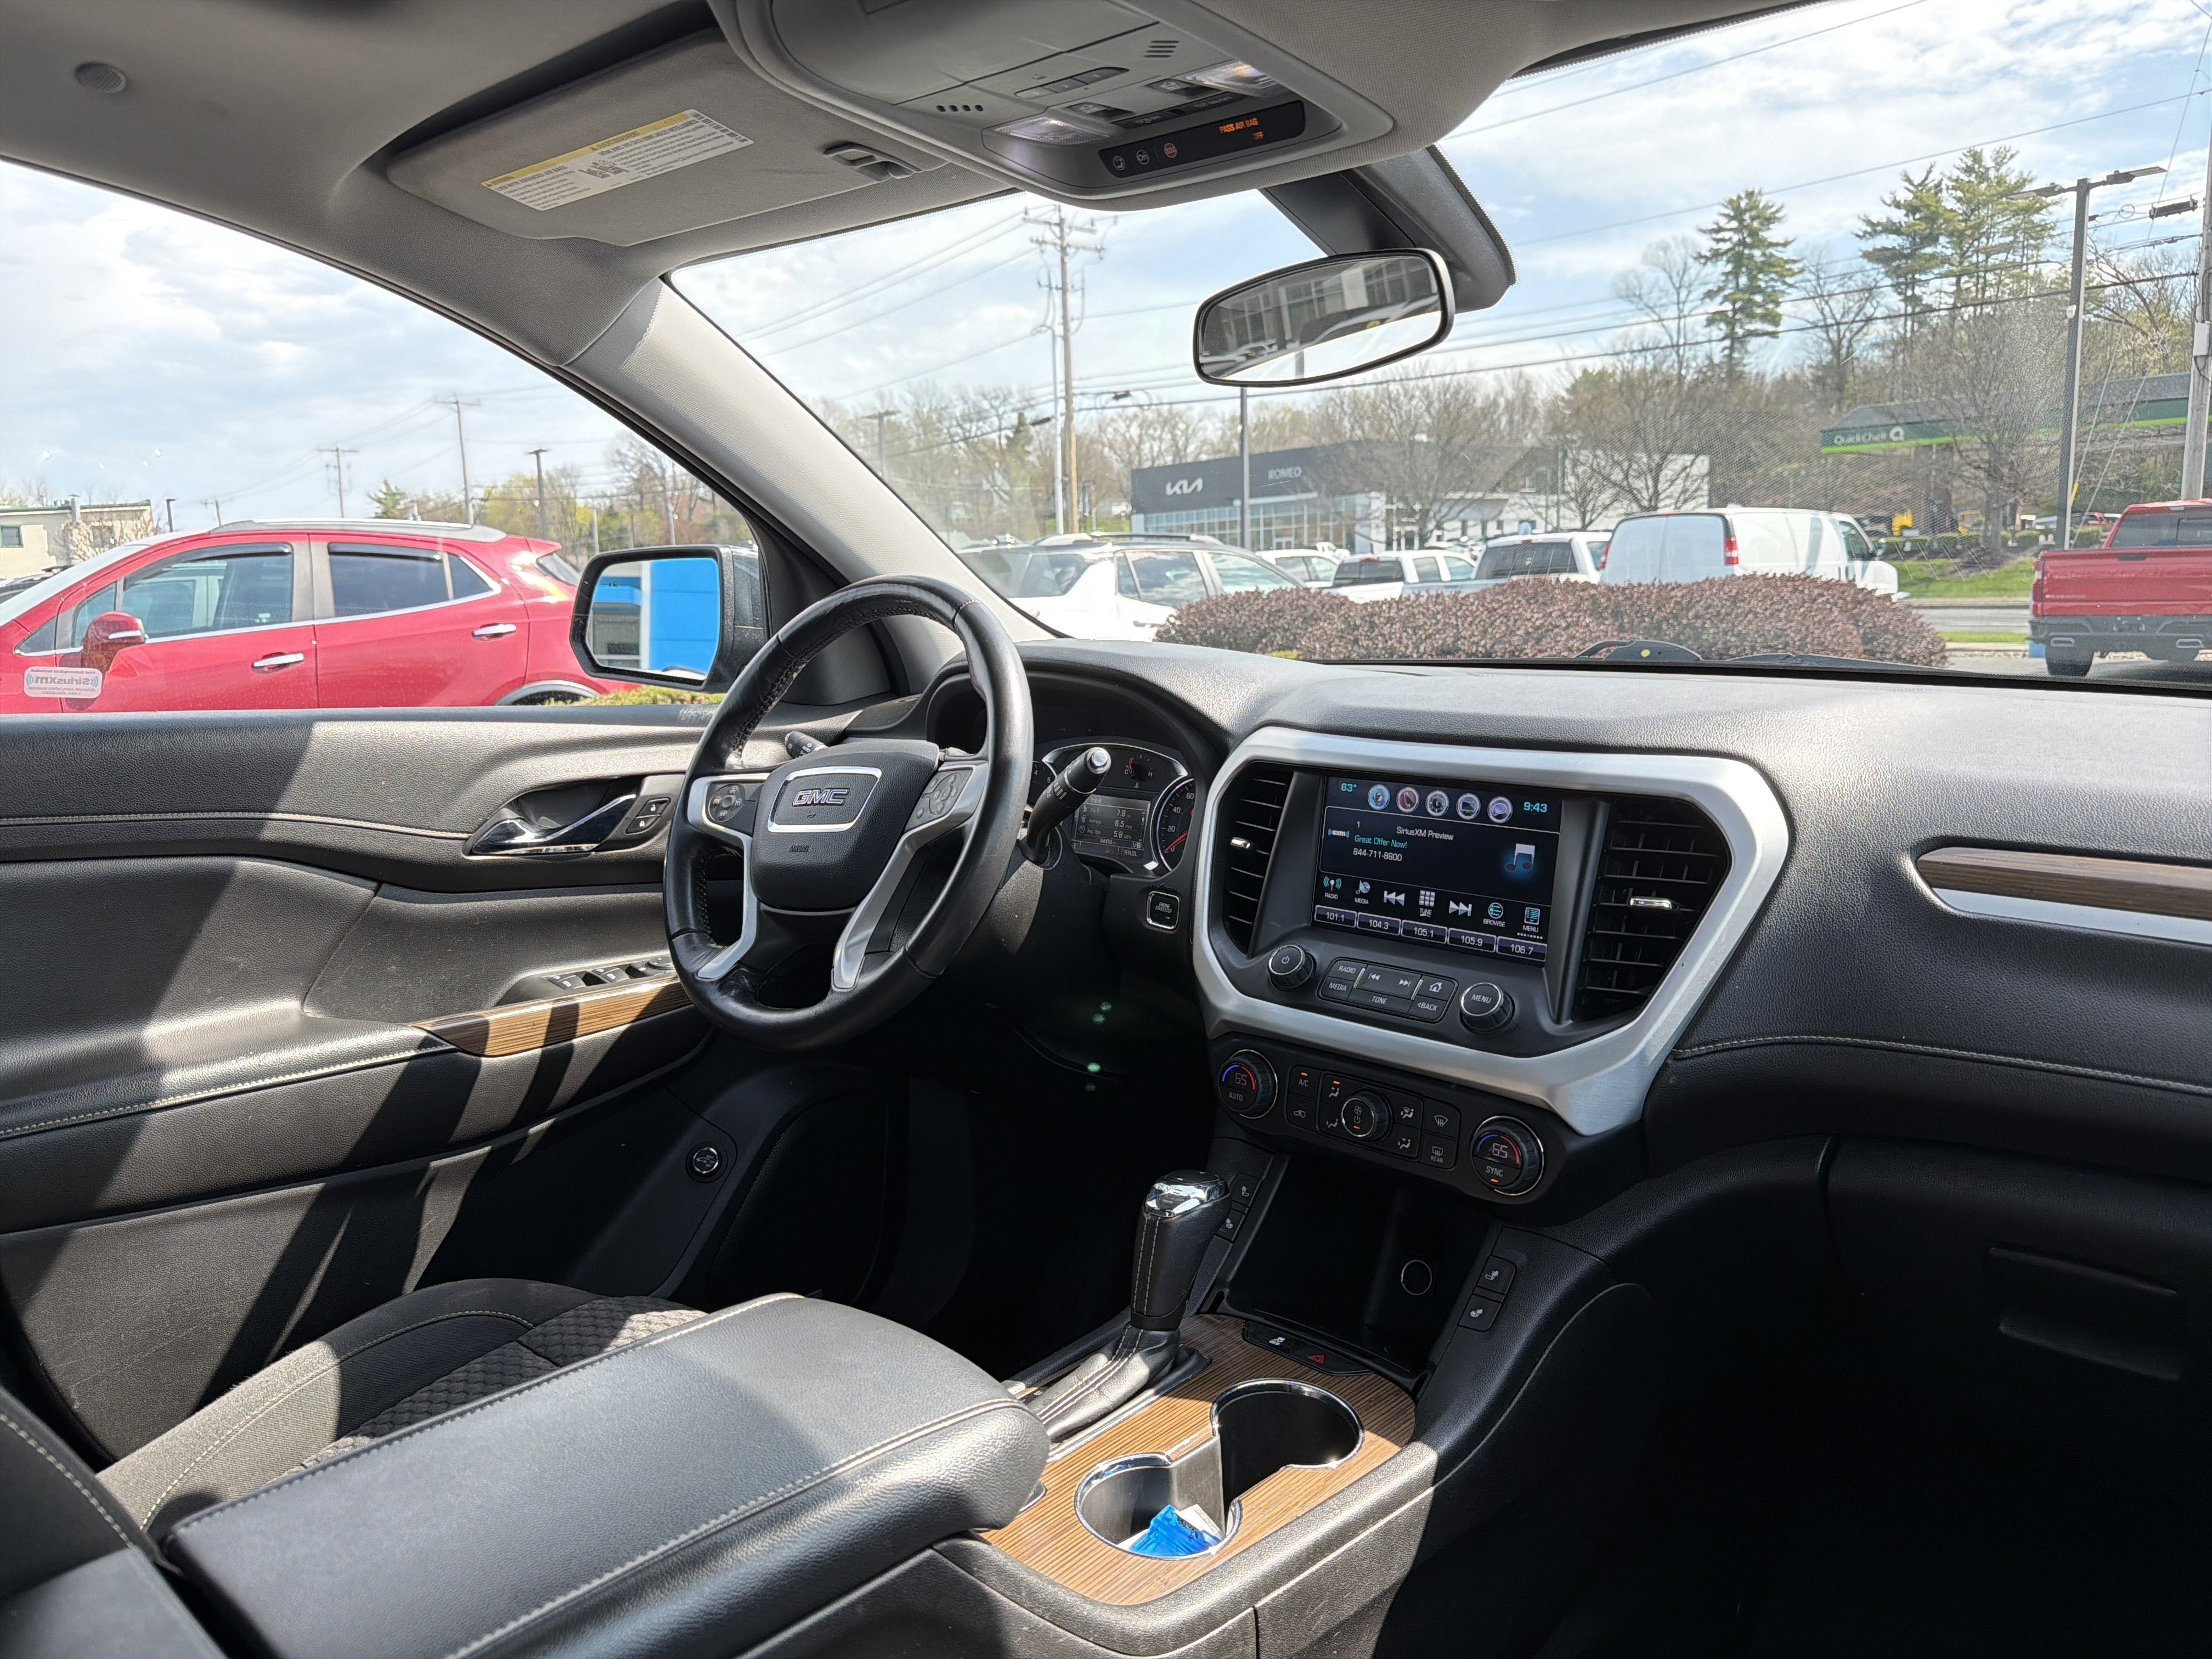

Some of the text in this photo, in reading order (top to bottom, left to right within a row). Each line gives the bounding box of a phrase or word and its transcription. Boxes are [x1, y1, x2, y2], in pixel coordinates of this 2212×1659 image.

[1219, 117, 1259, 133] PASS AIR BAG
[1252, 131, 1264, 140] OFF
[1165, 146, 1177, 155] SOS
[1268, 466, 1302, 481] ROMEO
[1165, 477, 1204, 496] KIA
[792, 788, 850, 806] GMC
[1116, 809, 1126, 817] 7.8
[1523, 802, 1548, 813] 9:43
[1113, 830, 1123, 838] 5.8
[1396, 826, 1454, 840] SiriusXM Preview
[1354, 834, 1407, 849] Great Offer Now!
[1353, 848, 1403, 861] 844-711-8800
[1325, 912, 1345, 922] 101.1
[1419, 907, 1432, 916] TUNE
[1369, 919, 1389, 930] 104.3
[1483, 918, 1505, 928] BROWSE
[1522, 924, 1539, 933] MENU
[1413, 927, 1434, 938] 105.1
[1460, 935, 1483, 946] 105.9
[1510, 944, 1534, 956] 106.7
[1338, 966, 1357, 974] RADIO
[1328, 982, 1347, 991] MEDIA
[1372, 996, 1388, 1005] TONE
[1471, 994, 1492, 1004] MENU
[1420, 1002, 1439, 1012] BACK
[1234, 1072, 1248, 1086] 65
[1298, 1078, 1309, 1087] A/C
[1228, 1091, 1243, 1102] AUTO
[1492, 1142, 1508, 1159] 65
[1431, 1155, 1443, 1164] REAR
[1486, 1165, 1504, 1178] SYNC
